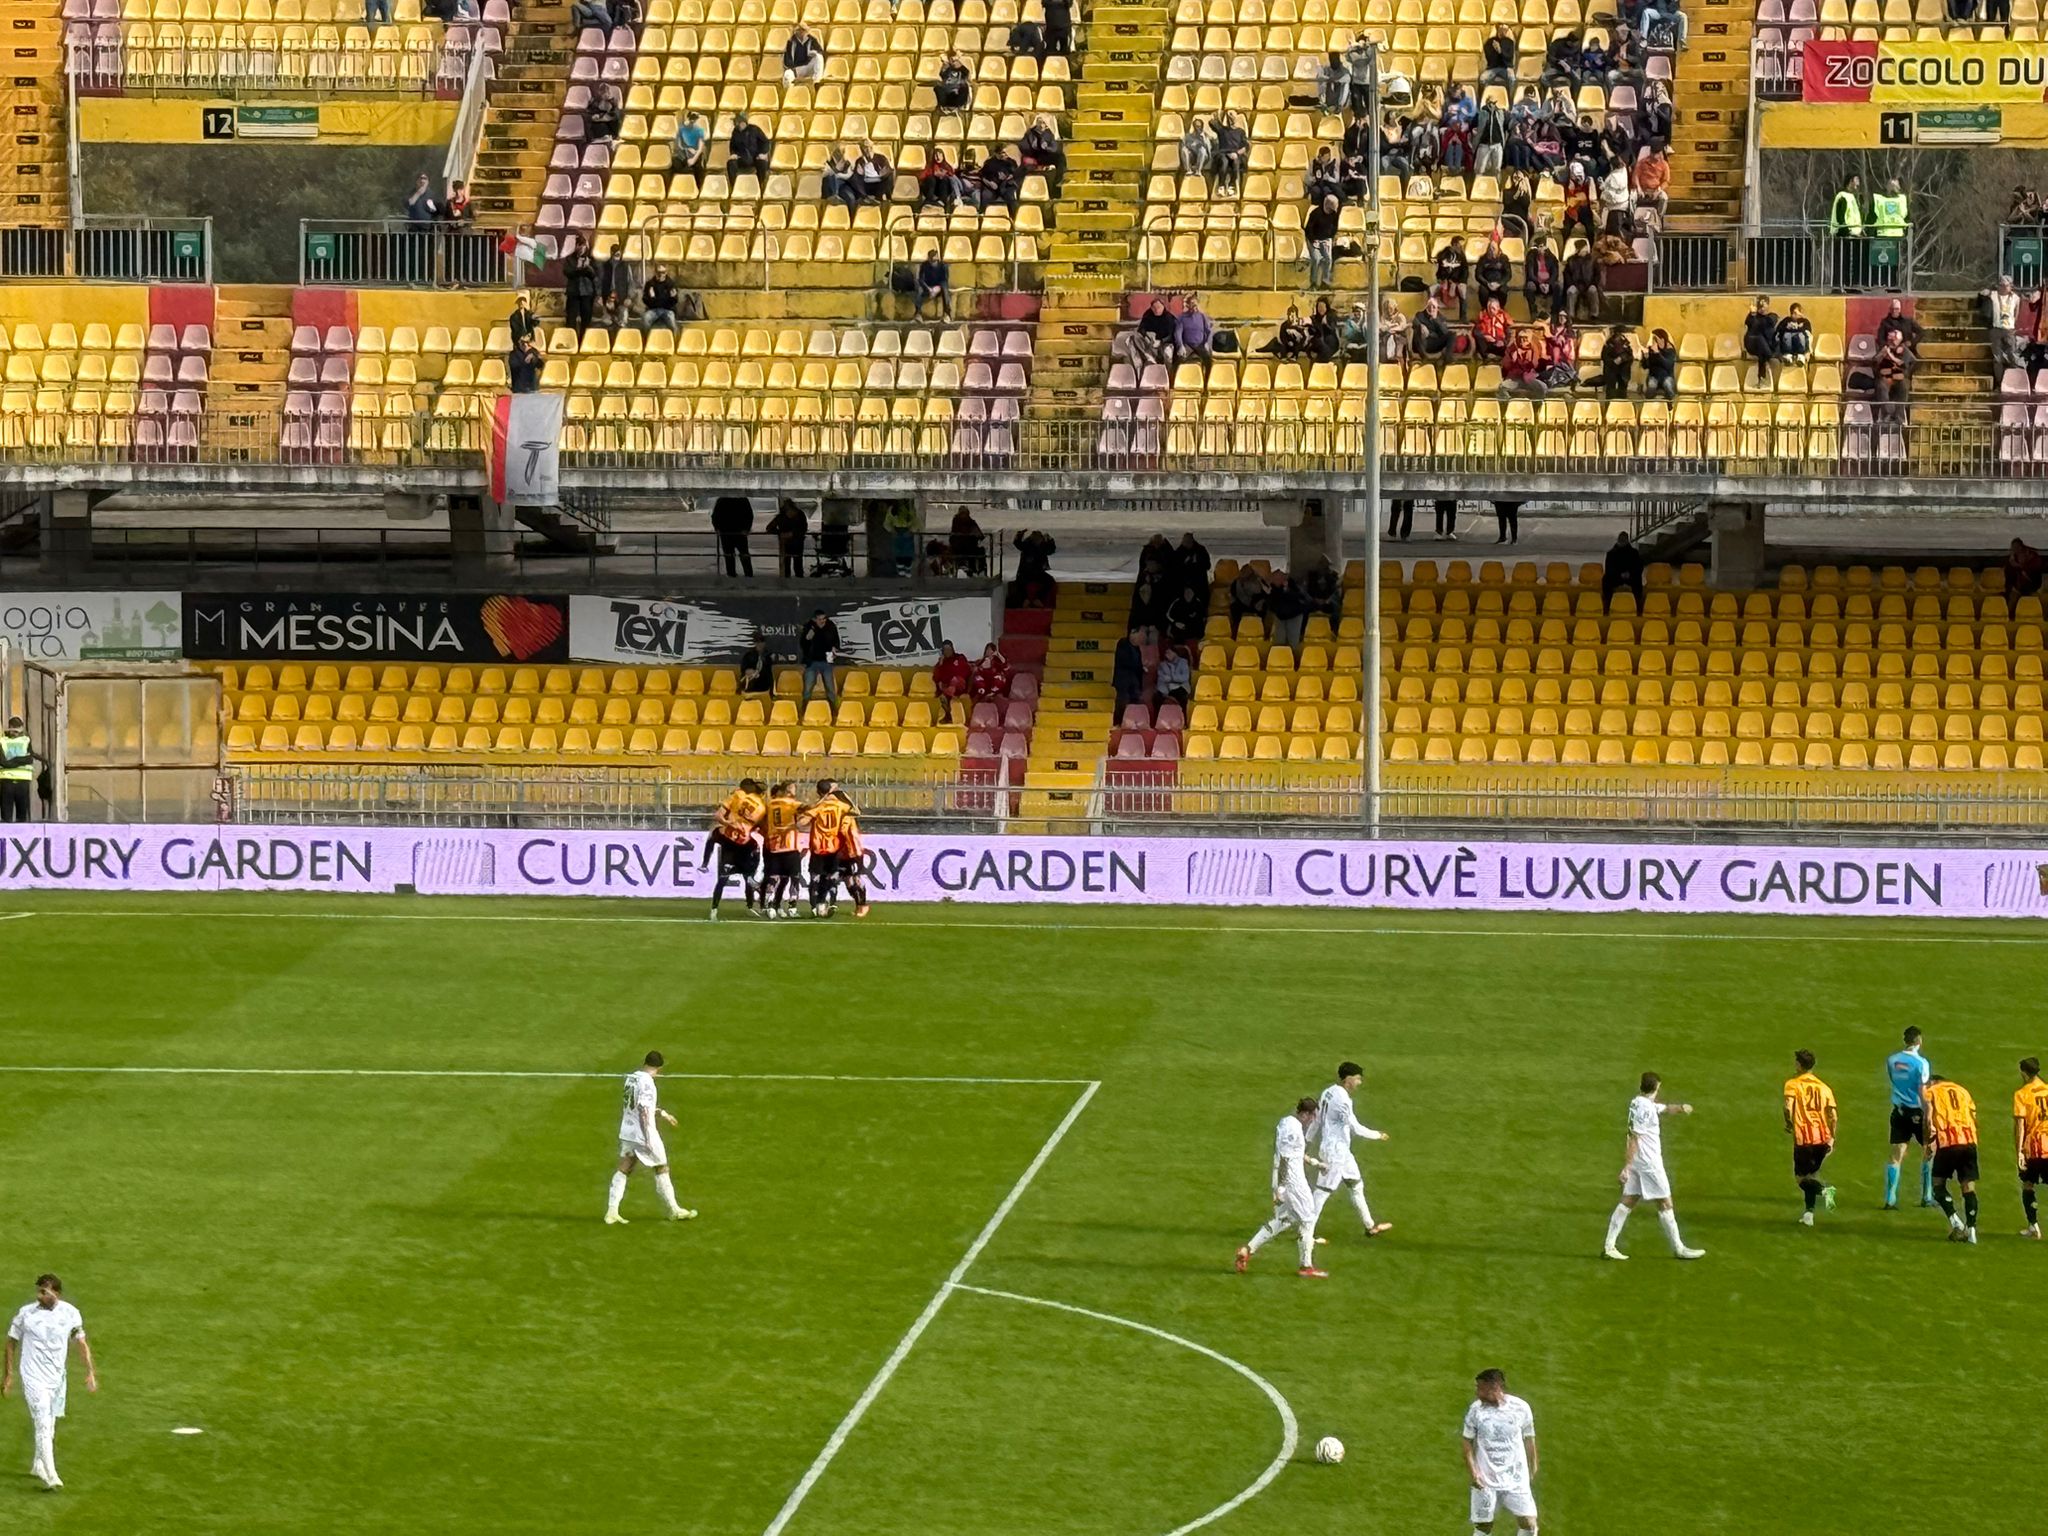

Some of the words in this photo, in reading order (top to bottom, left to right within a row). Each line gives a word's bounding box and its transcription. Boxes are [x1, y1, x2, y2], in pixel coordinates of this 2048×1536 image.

[1825, 56, 1985, 88] ZOCCOLO
[1998, 56, 2045, 87] DU
[206, 113, 233, 134] 12
[1883, 117, 1910, 139] 11
[4, 604, 92, 637] ogia
[240, 601, 322, 613] GRAN
[195, 608, 225, 646] M
[240, 614, 464, 652] MESSINA
[610, 601, 688, 656] Texi
[861, 603, 944, 657] Texi
[0, 837, 143, 880] XURY
[161, 838, 372, 882] GARDEN
[518, 836, 695, 887] CURVÈ
[931, 849, 1146, 894] GARDEN
[1296, 846, 1477, 898] CURVÈ
[1500, 855, 1702, 901] LUXURY
[1720, 859, 1943, 907] GARDEN
[1806, 1085, 1821, 1112] 20
